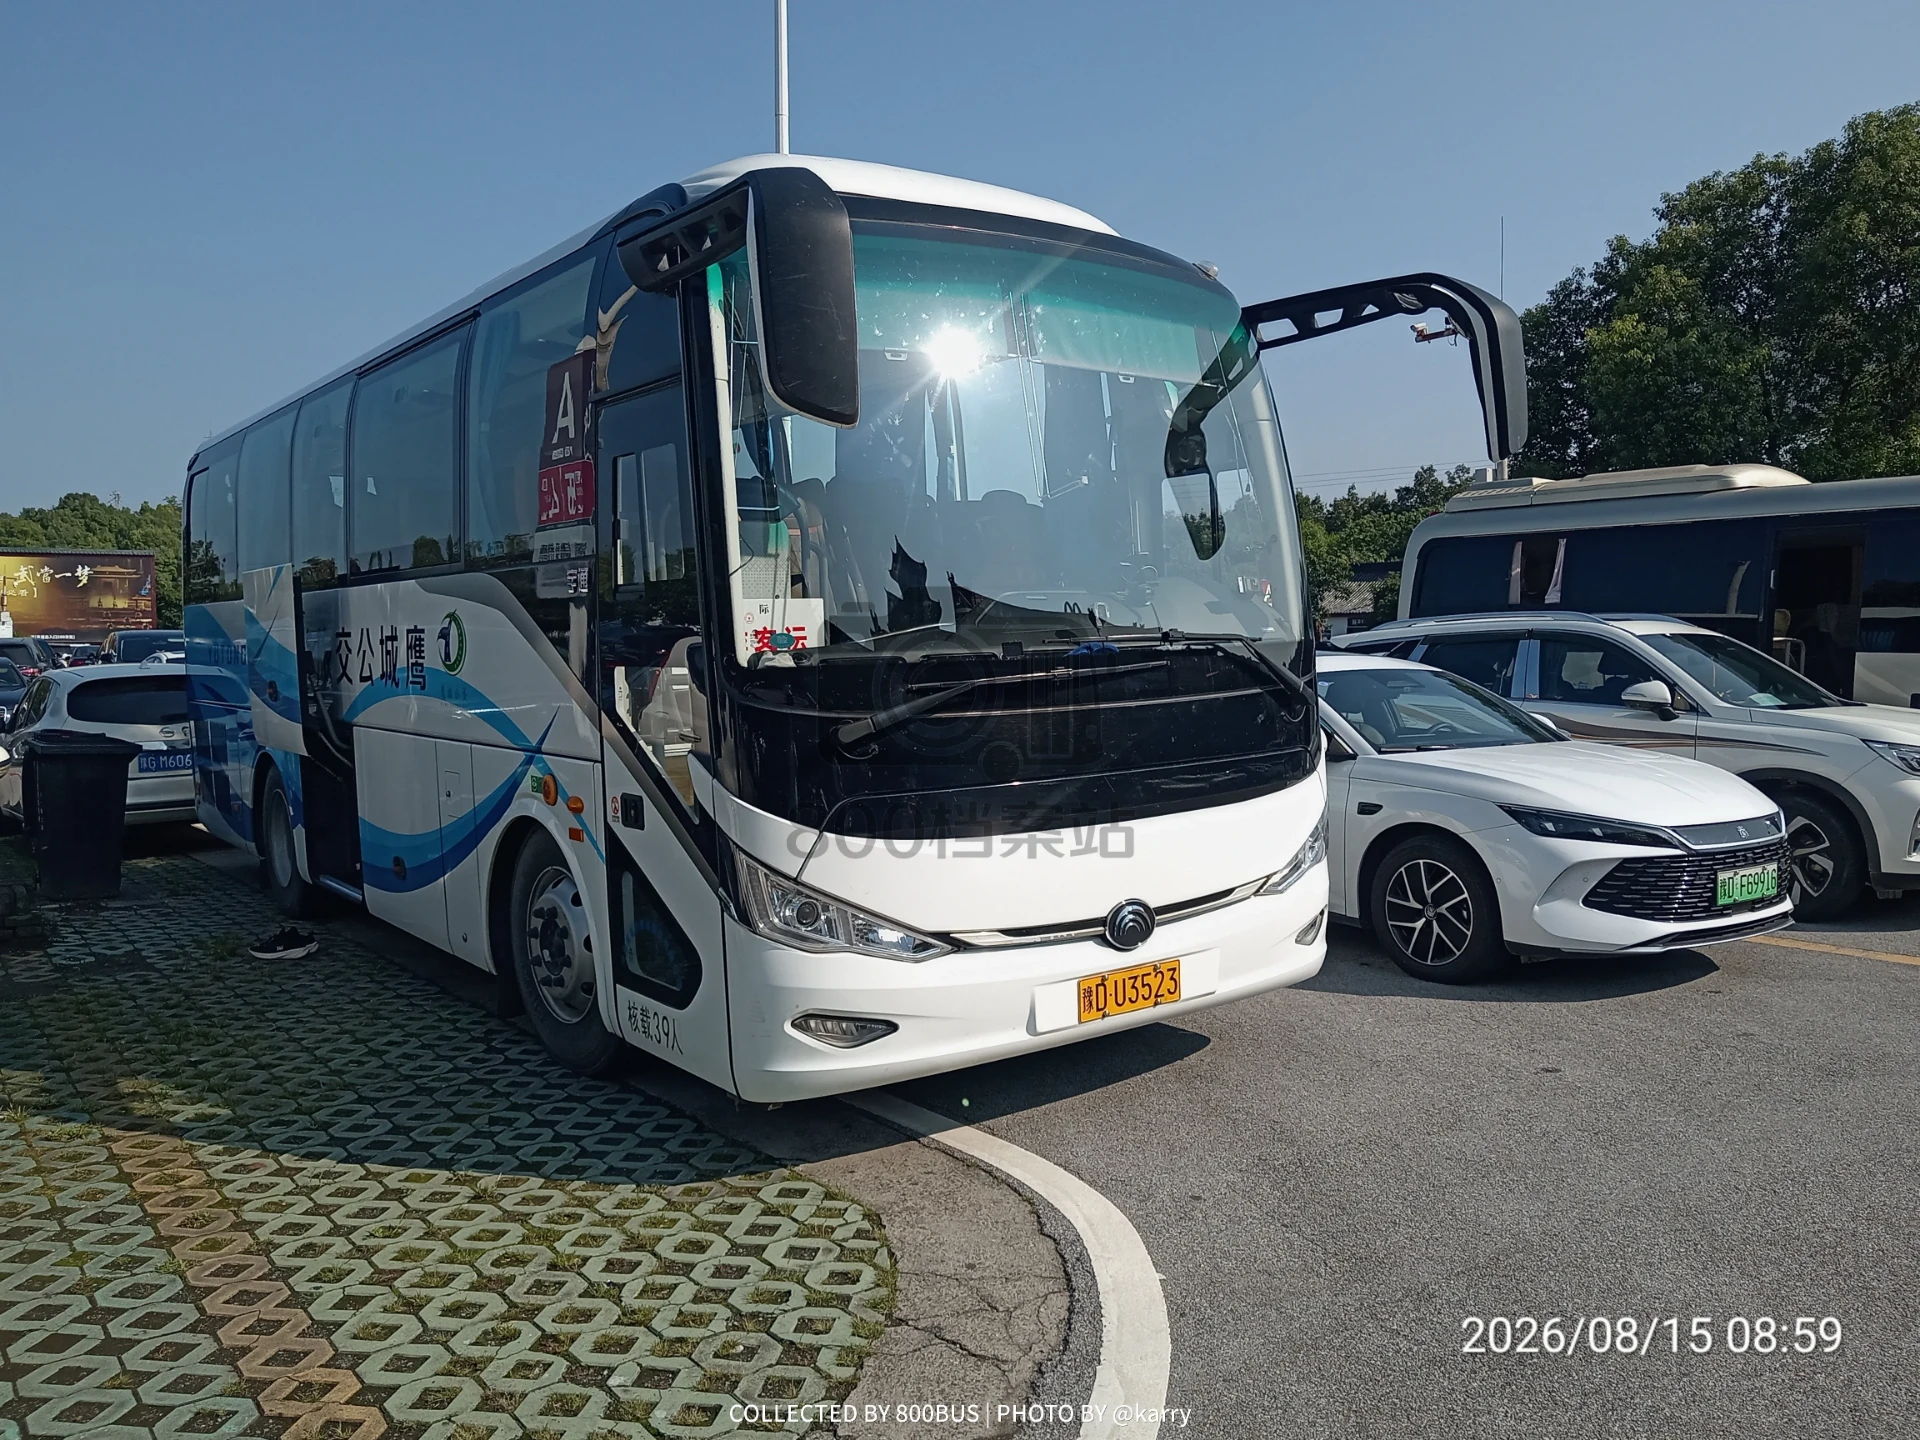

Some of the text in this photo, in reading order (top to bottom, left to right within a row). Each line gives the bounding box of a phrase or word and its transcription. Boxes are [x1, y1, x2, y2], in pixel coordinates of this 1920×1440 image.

[745, 625, 808, 652] 客运
[627, 999, 684, 1055] 核载39人
